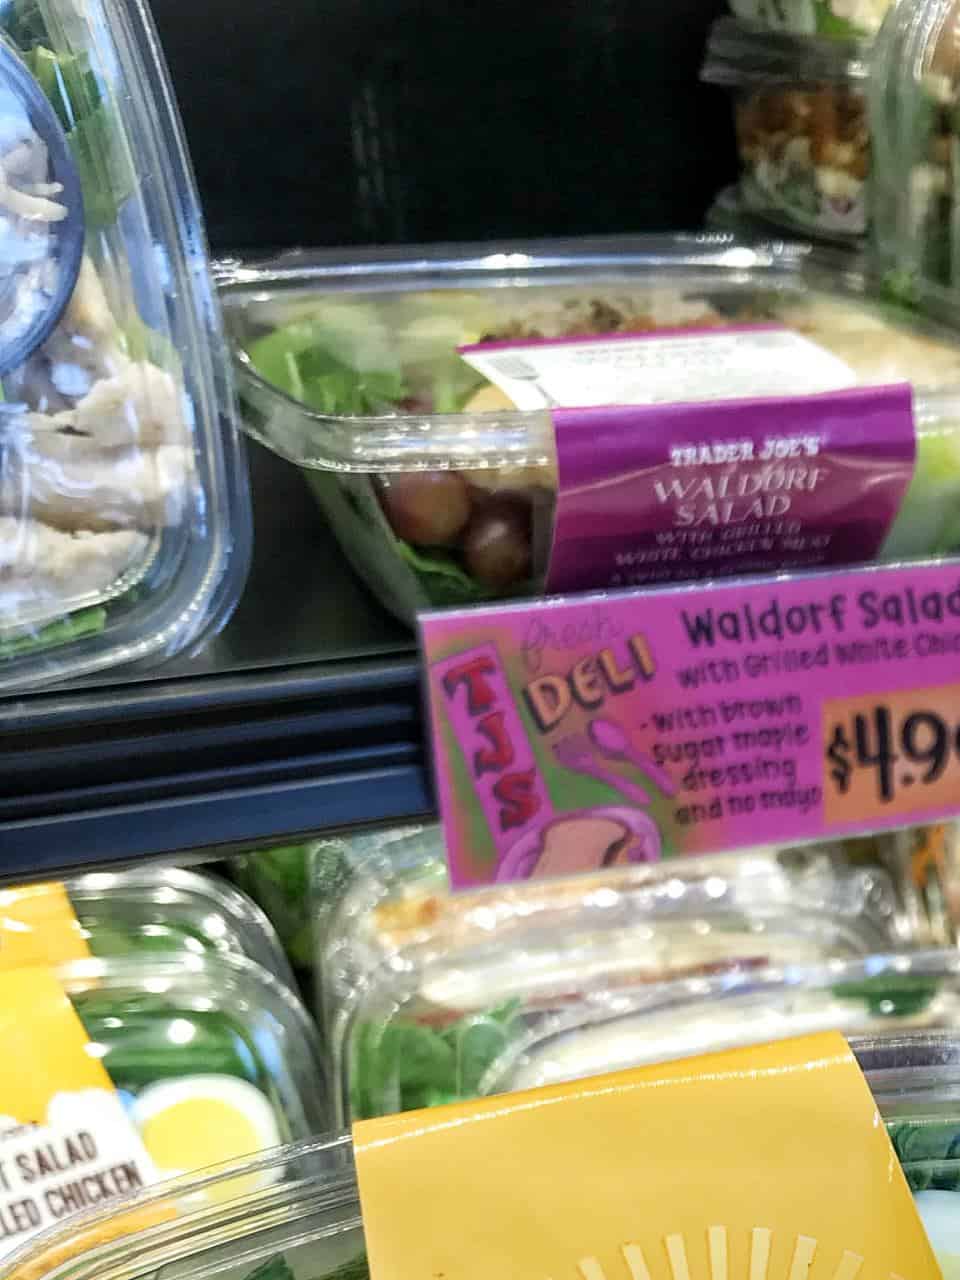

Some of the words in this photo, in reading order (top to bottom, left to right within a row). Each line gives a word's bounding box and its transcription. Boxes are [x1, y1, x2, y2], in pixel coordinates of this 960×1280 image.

[669, 441, 754, 467] TRADER
[758, 435, 822, 459] JOE'S
[654, 463, 829, 503] WALDORF
[673, 495, 791, 527] SALAD
[680, 594, 848, 648] Waldorf
[522, 632, 658, 735] DELI
[675, 656, 740, 689] with
[718, 694, 803, 721] brown
[681, 756, 798, 791] dressing
[674, 795, 723, 825] and
[15, 1129, 98, 1183] SALAD
[44, 1159, 144, 1219] CHICKEN
